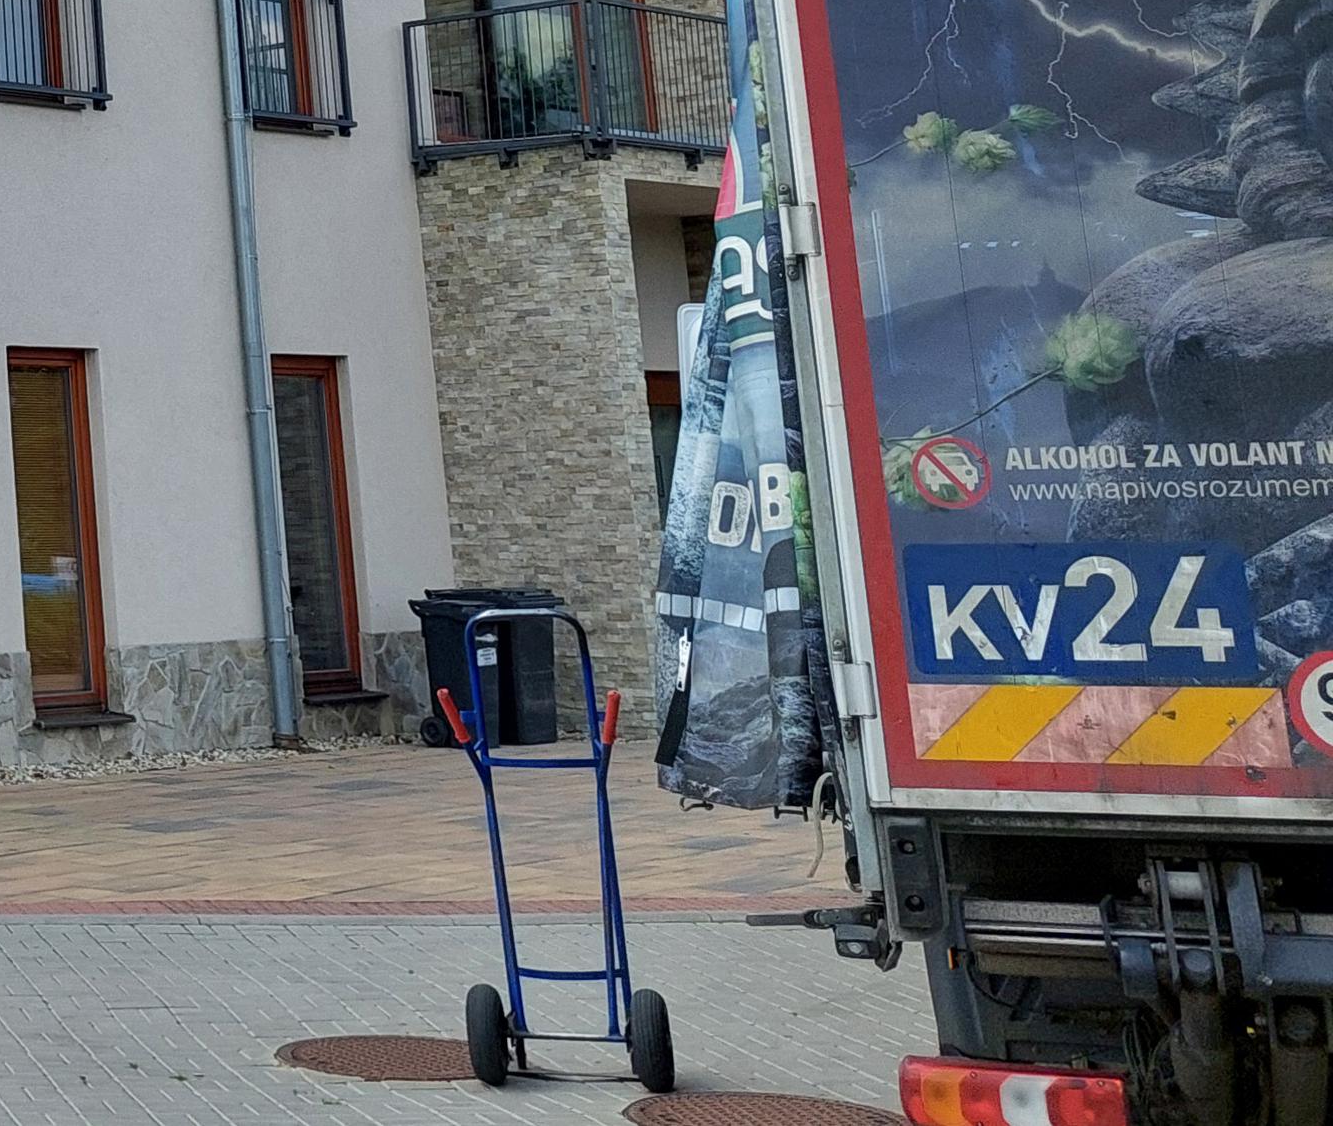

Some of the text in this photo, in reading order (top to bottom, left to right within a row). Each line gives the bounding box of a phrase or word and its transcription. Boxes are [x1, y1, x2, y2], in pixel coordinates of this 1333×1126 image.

[1005, 444, 1137, 471] ALKOHOL
[1143, 443, 1182, 468] ZA
[1188, 440, 1305, 467] VOLANT
[927, 555, 1236, 663] KV24
